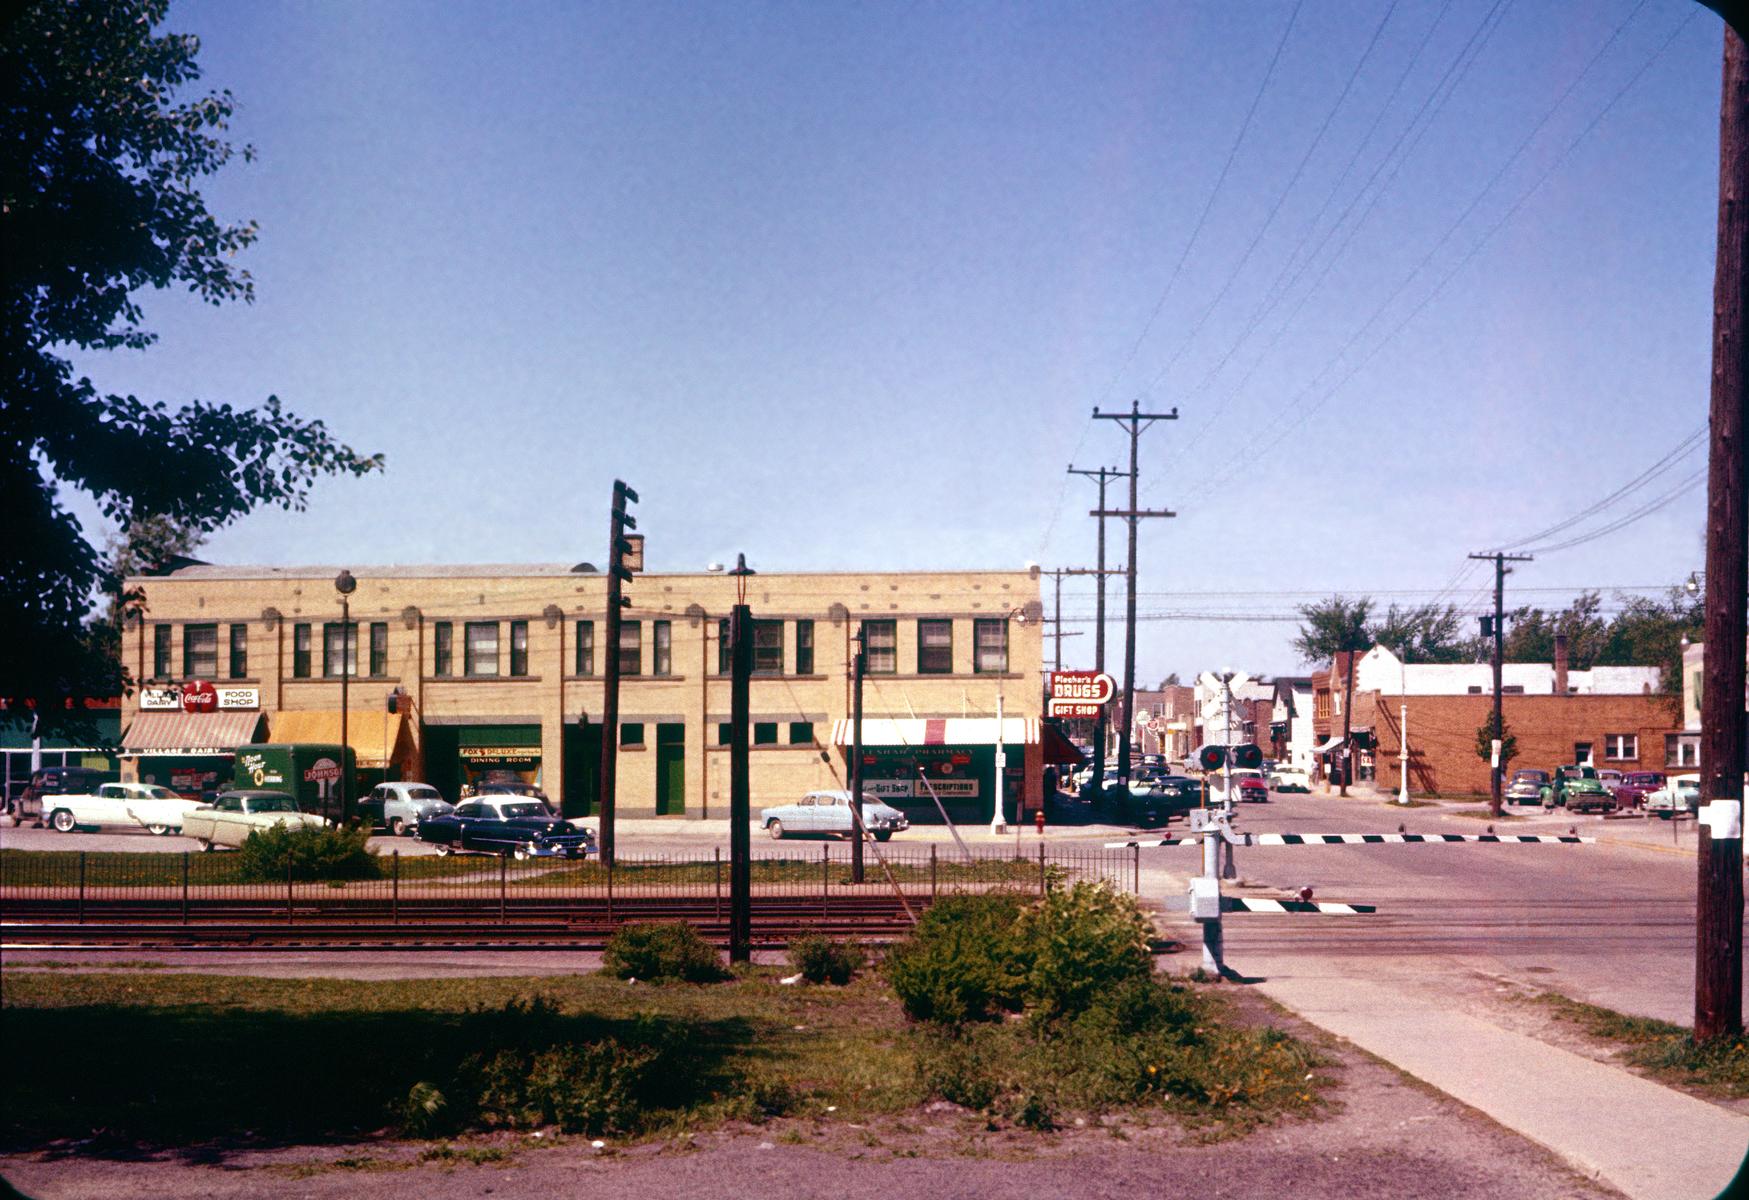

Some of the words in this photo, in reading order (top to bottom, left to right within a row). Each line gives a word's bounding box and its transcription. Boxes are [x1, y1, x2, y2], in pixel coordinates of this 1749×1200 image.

[1054, 684, 1101, 698] DRUGS
[1054, 705, 1074, 715] GIFT
[1076, 705, 1098, 715] SHOP
